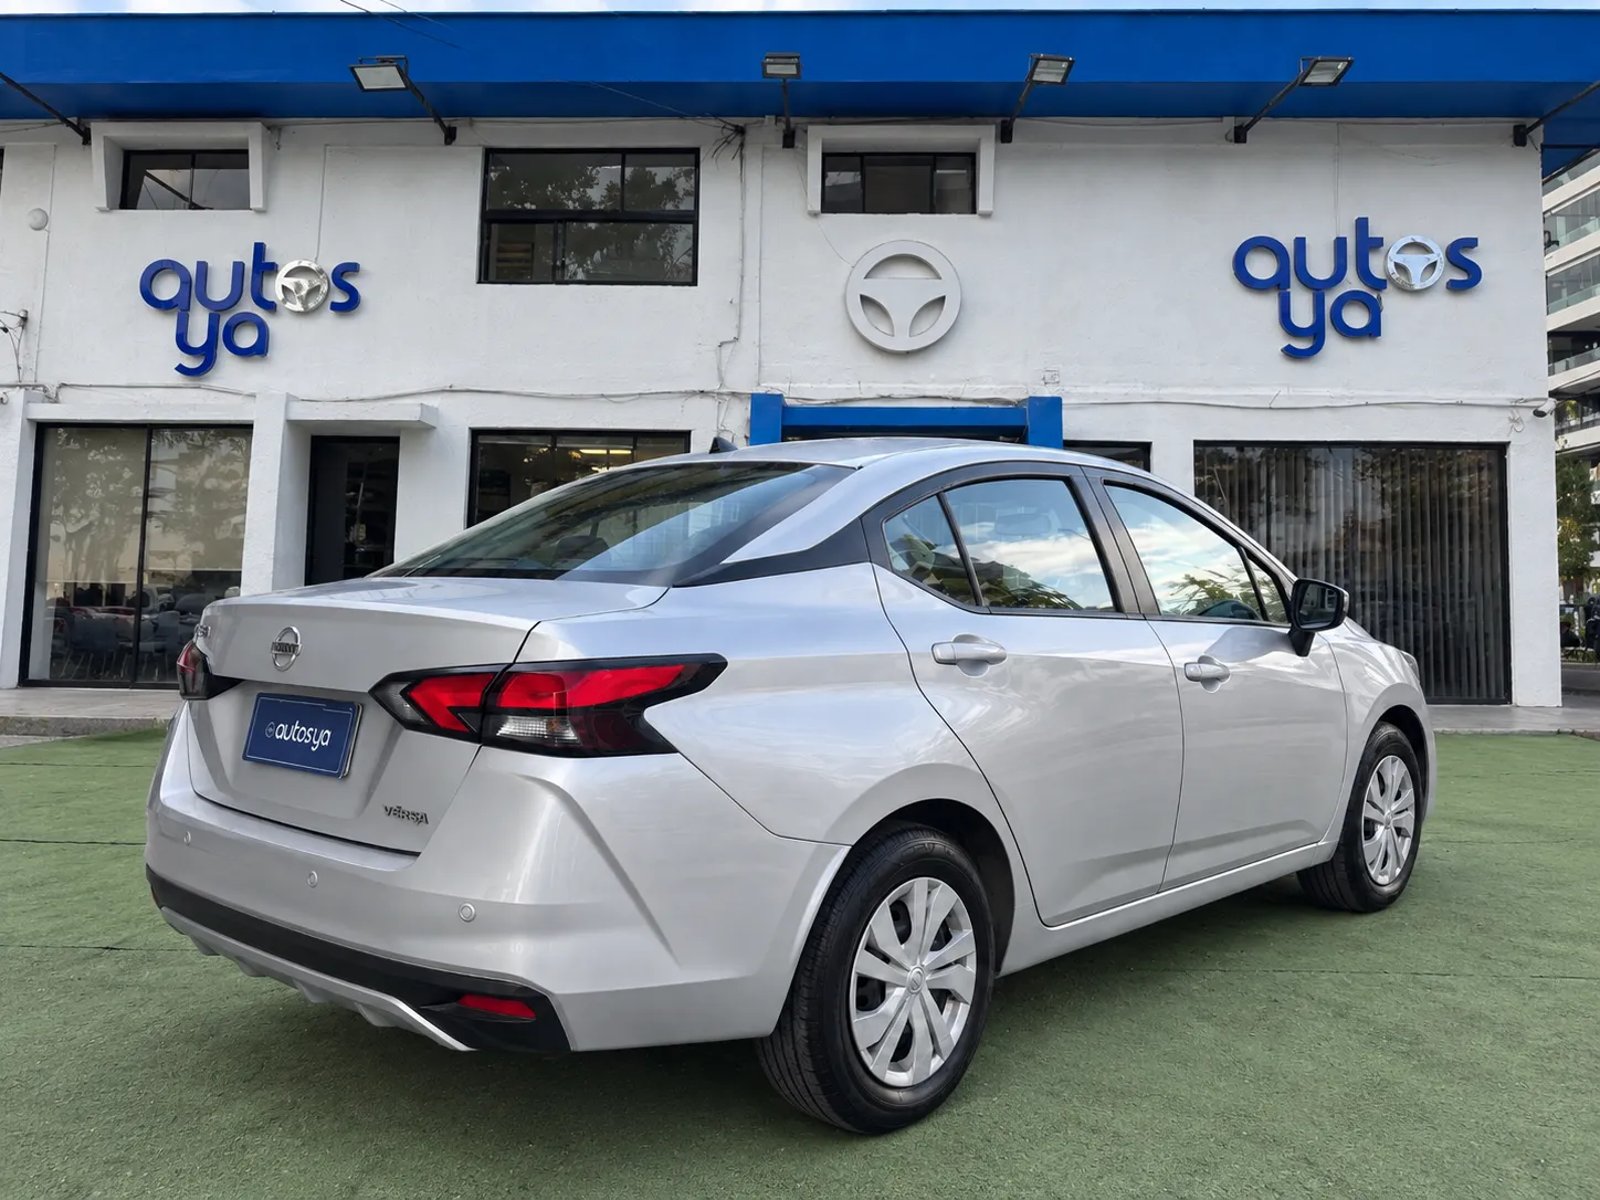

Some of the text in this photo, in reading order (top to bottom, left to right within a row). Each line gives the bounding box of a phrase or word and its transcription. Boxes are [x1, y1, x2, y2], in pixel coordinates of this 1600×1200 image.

[139, 242, 361, 312] autos
[1232, 216, 1483, 290] autos
[174, 311, 270, 377] ya
[1278, 289, 1382, 359] ya
[275, 720, 331, 751] autosya
